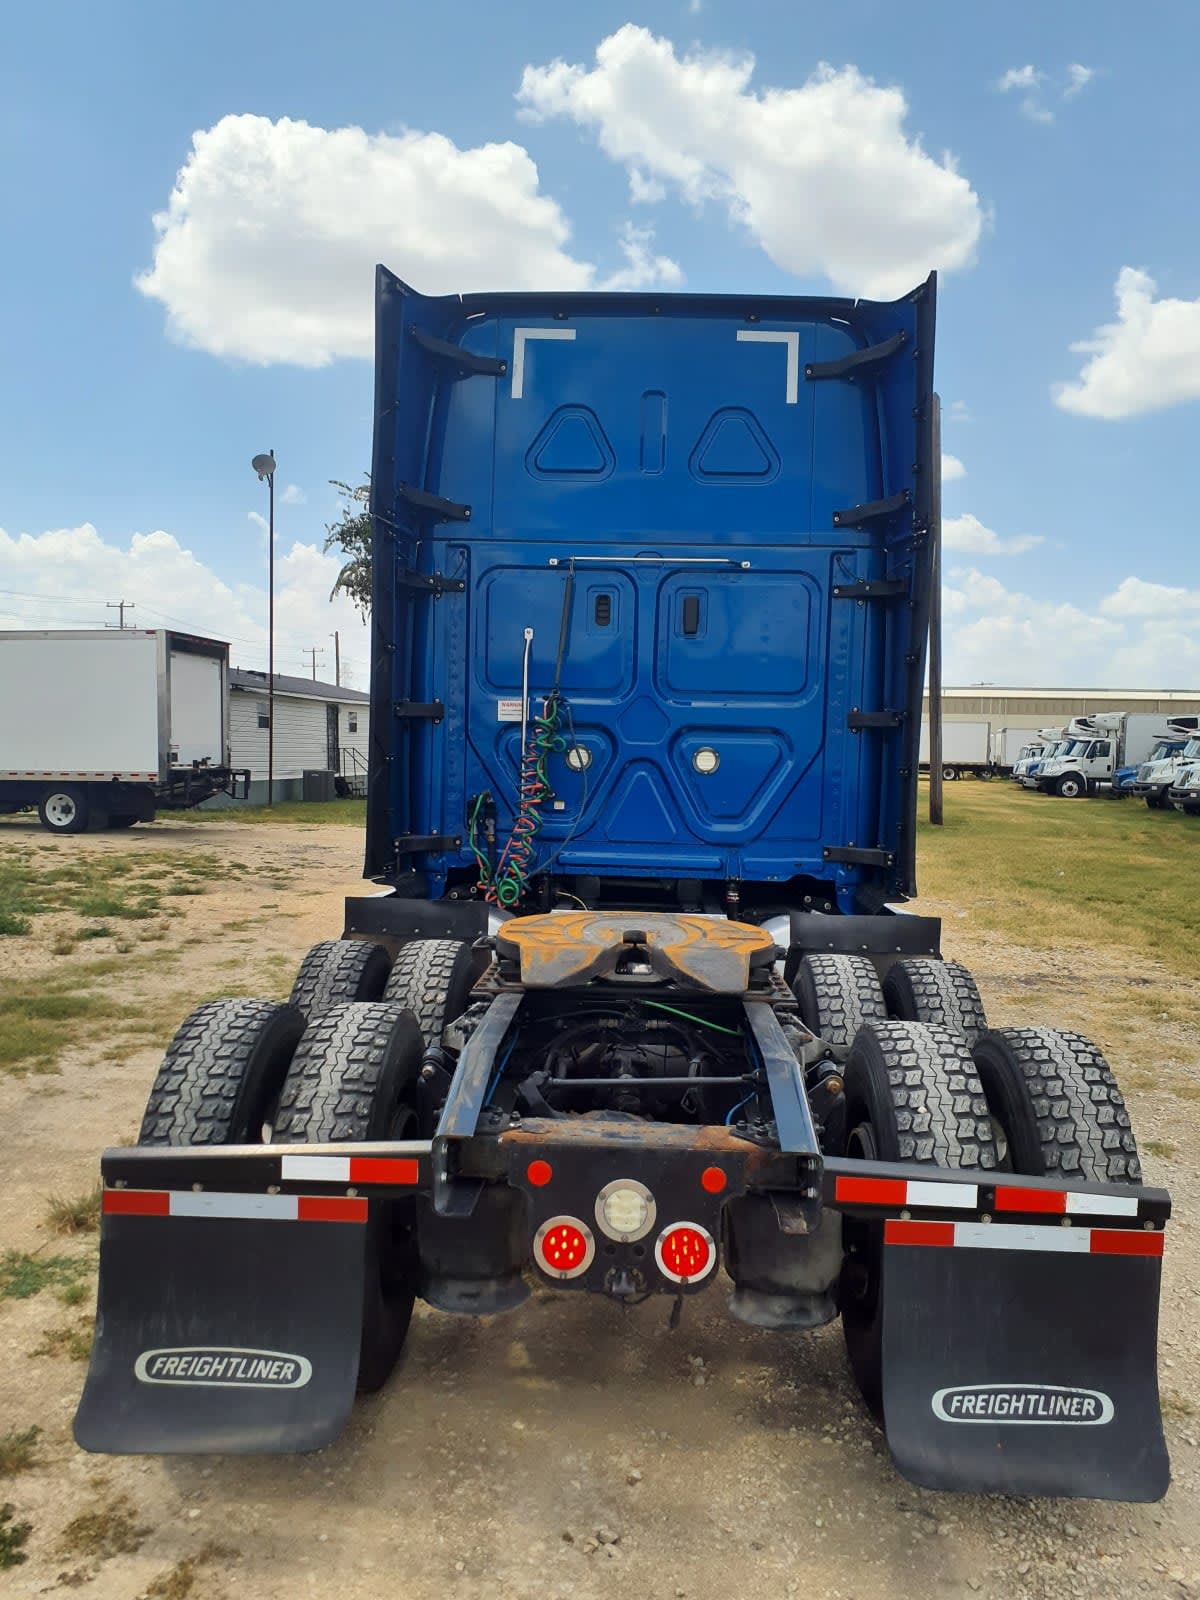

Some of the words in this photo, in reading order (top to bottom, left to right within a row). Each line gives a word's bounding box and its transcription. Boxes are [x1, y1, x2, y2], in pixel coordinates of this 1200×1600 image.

[500, 701, 524, 709] WARNIN
[151, 1356, 296, 1380] FREIGHTLINER
[950, 1394, 1096, 1416] FREIGHTLINER
